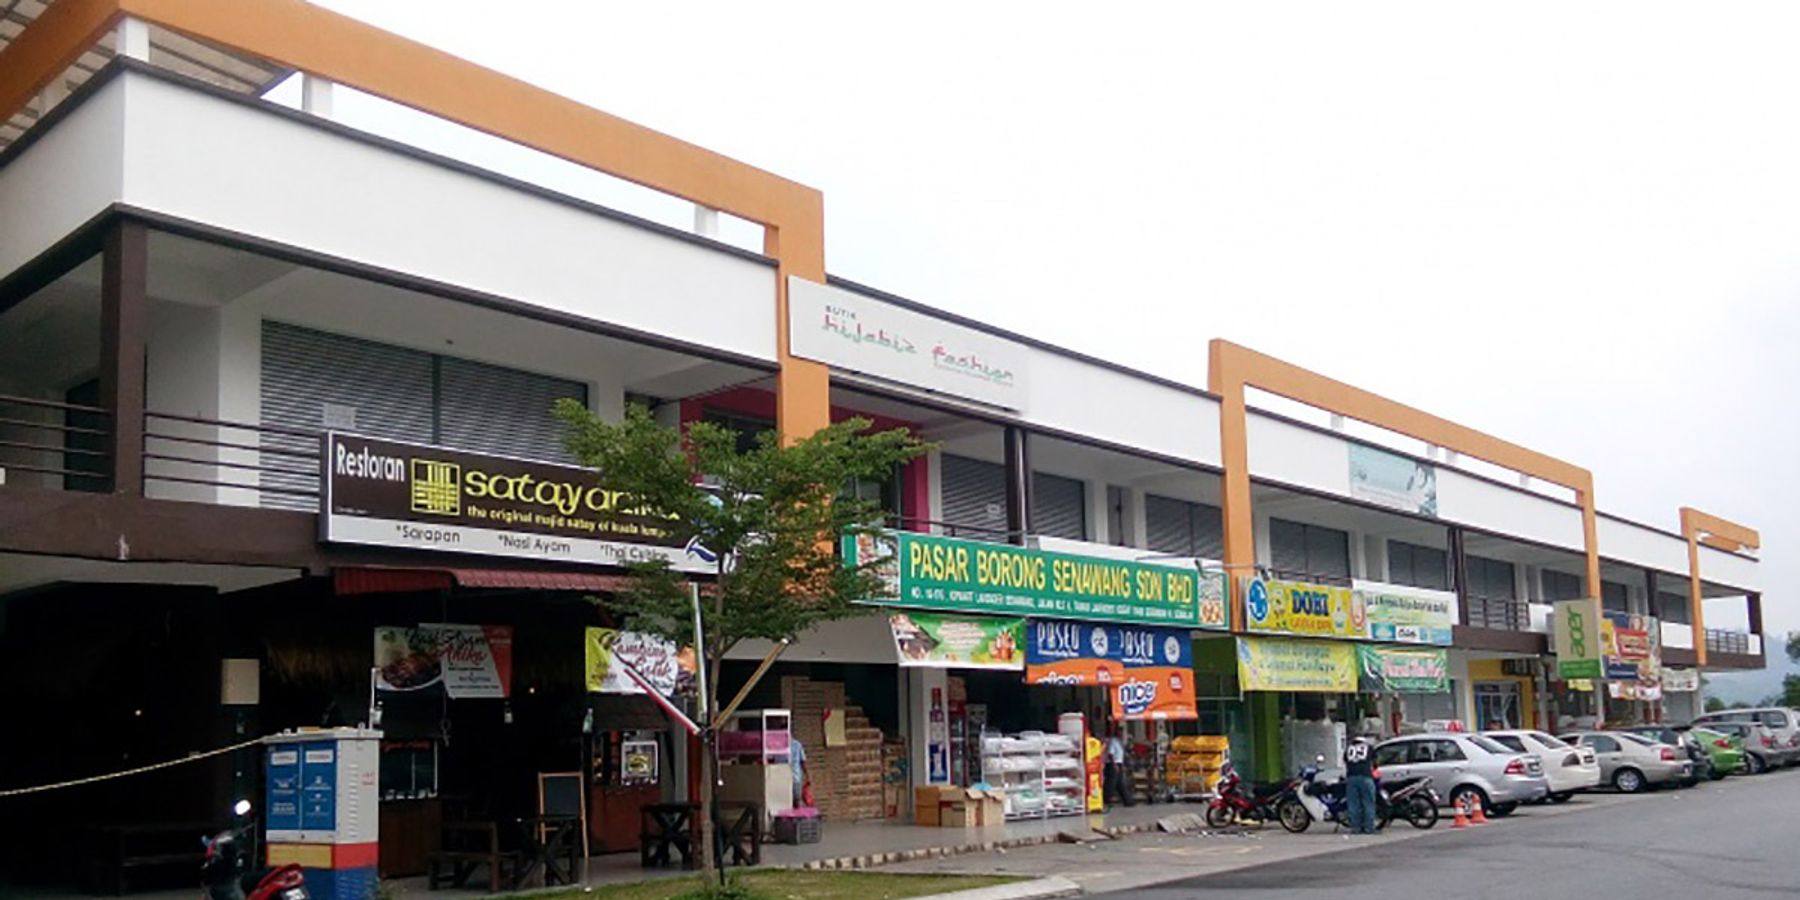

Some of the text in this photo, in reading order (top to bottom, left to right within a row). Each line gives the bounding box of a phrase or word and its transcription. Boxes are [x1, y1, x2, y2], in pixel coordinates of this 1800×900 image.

[336, 443, 405, 482] Restoran
[464, 470, 582, 515] satay
[467, 506, 486, 518] the
[490, 507, 532, 524] original
[567, 517, 595, 533] satay
[598, 519, 609, 531] of
[612, 520, 639, 534] kuala
[533, 536, 571, 554] Ayam
[910, 541, 1193, 603] PASAR BORONG SENAWANG SDN BHD
[1291, 589, 1329, 616] DOBI
[1037, 622, 1080, 650] PASEO
[1566, 604, 1585, 657] acer
[1347, 743, 1368, 761] 09
